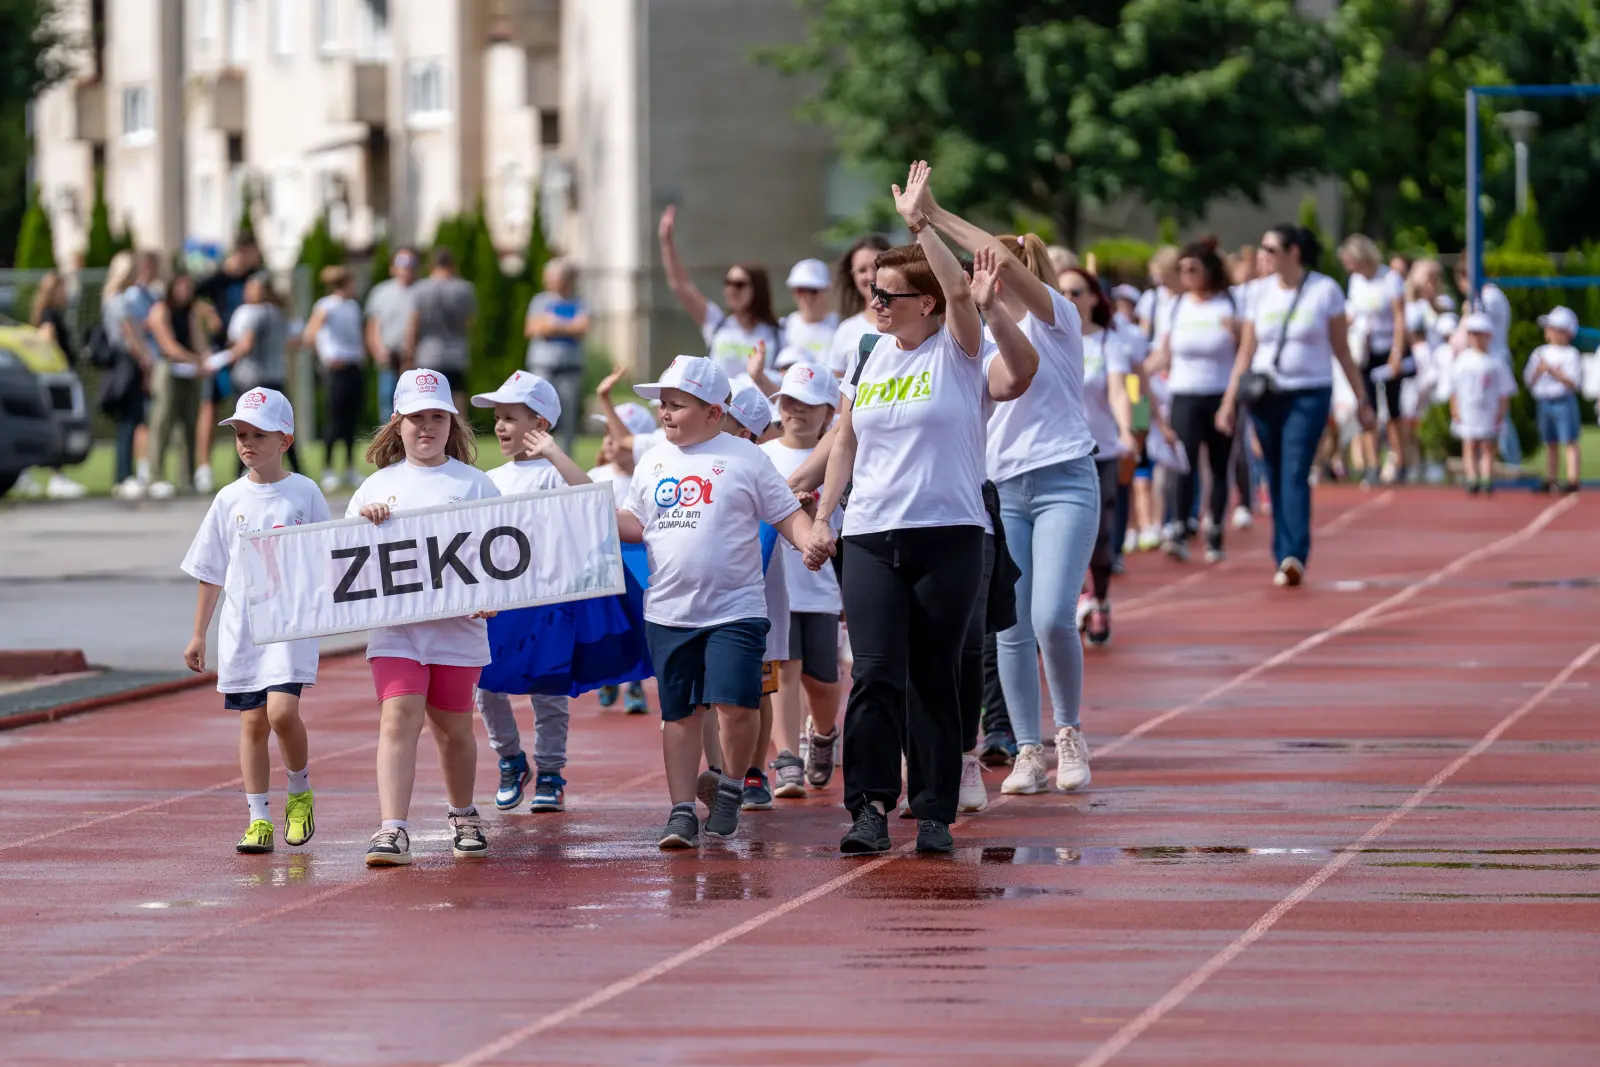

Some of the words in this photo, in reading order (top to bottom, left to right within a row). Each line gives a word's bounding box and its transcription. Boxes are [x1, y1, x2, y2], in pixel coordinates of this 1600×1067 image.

[912, 383, 931, 397] 24
[685, 510, 701, 519] BITI
[658, 520, 698, 530] OLIMPIJAC
[331, 525, 531, 603] ZEKO
